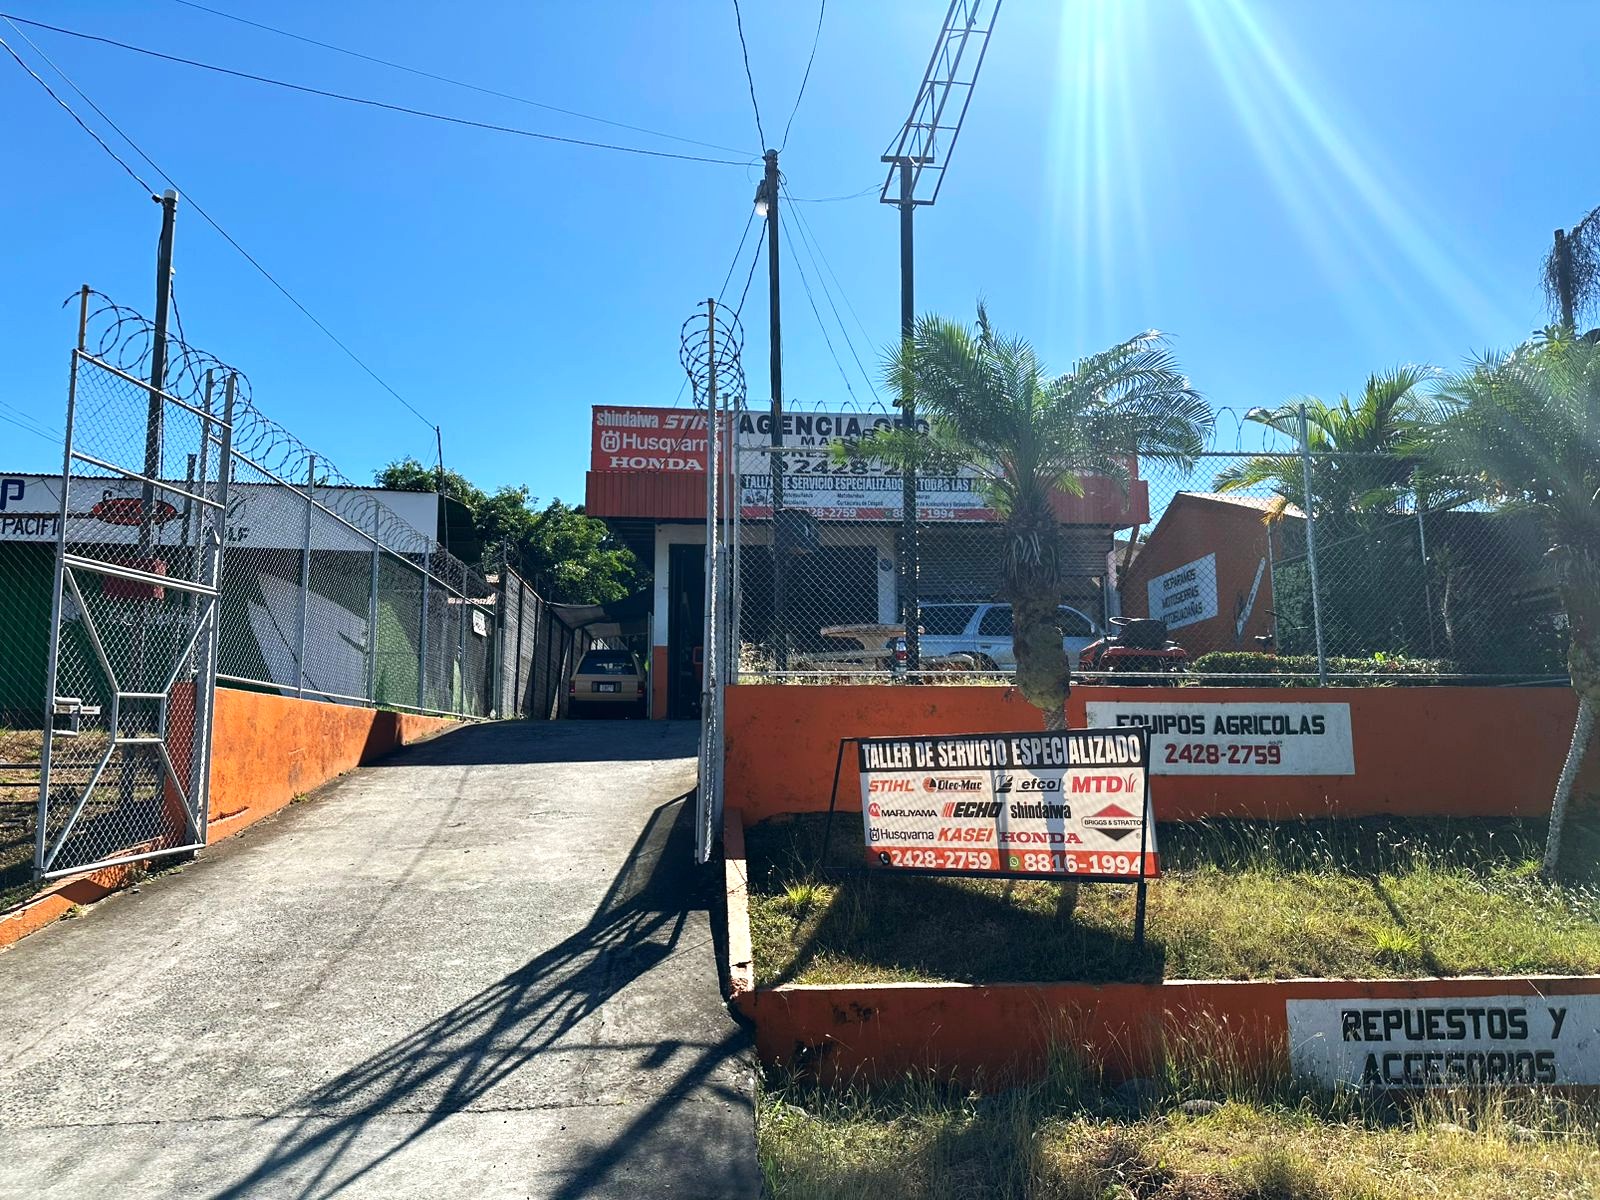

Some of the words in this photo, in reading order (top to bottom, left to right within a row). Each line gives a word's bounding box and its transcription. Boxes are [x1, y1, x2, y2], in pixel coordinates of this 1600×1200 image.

[597, 410, 658, 428] shindaiwa
[740, 414, 862, 437] AGENCIA
[609, 456, 703, 471] HONDA
[792, 476, 833, 490] SERVICIO
[919, 478, 949, 492] TODAS
[951, 479, 969, 492] LAS
[2, 518, 63, 536] PACIFI
[1213, 715, 1325, 736] AGRICOLAS
[862, 743, 912, 769] TALLER
[915, 741, 935, 768] DE
[938, 739, 1007, 768] SERVICIO
[1011, 734, 1141, 766] ESPECIALIZADO
[1164, 743, 1281, 765] 2428-2759
[869, 780, 914, 792] STIHL
[938, 779, 982, 791] Oleo-Mac
[1021, 778, 1056, 790] efco
[1072, 776, 1123, 793] MTD
[881, 809, 938, 817] MARUYAMA
[953, 802, 1003, 818] ECHO
[1010, 801, 1072, 819] shindaiwa
[880, 829, 935, 841] Husqvarna
[937, 827, 994, 842] KASEI
[1000, 831, 1083, 844] HONDA
[891, 850, 992, 870] 2428-2759
[1023, 853, 1141, 875] 8816-1994
[1341, 1007, 1528, 1042] REPUESTOS
[1549, 1007, 1567, 1040] Y
[1363, 1049, 1556, 1085] ACCESORIOS
